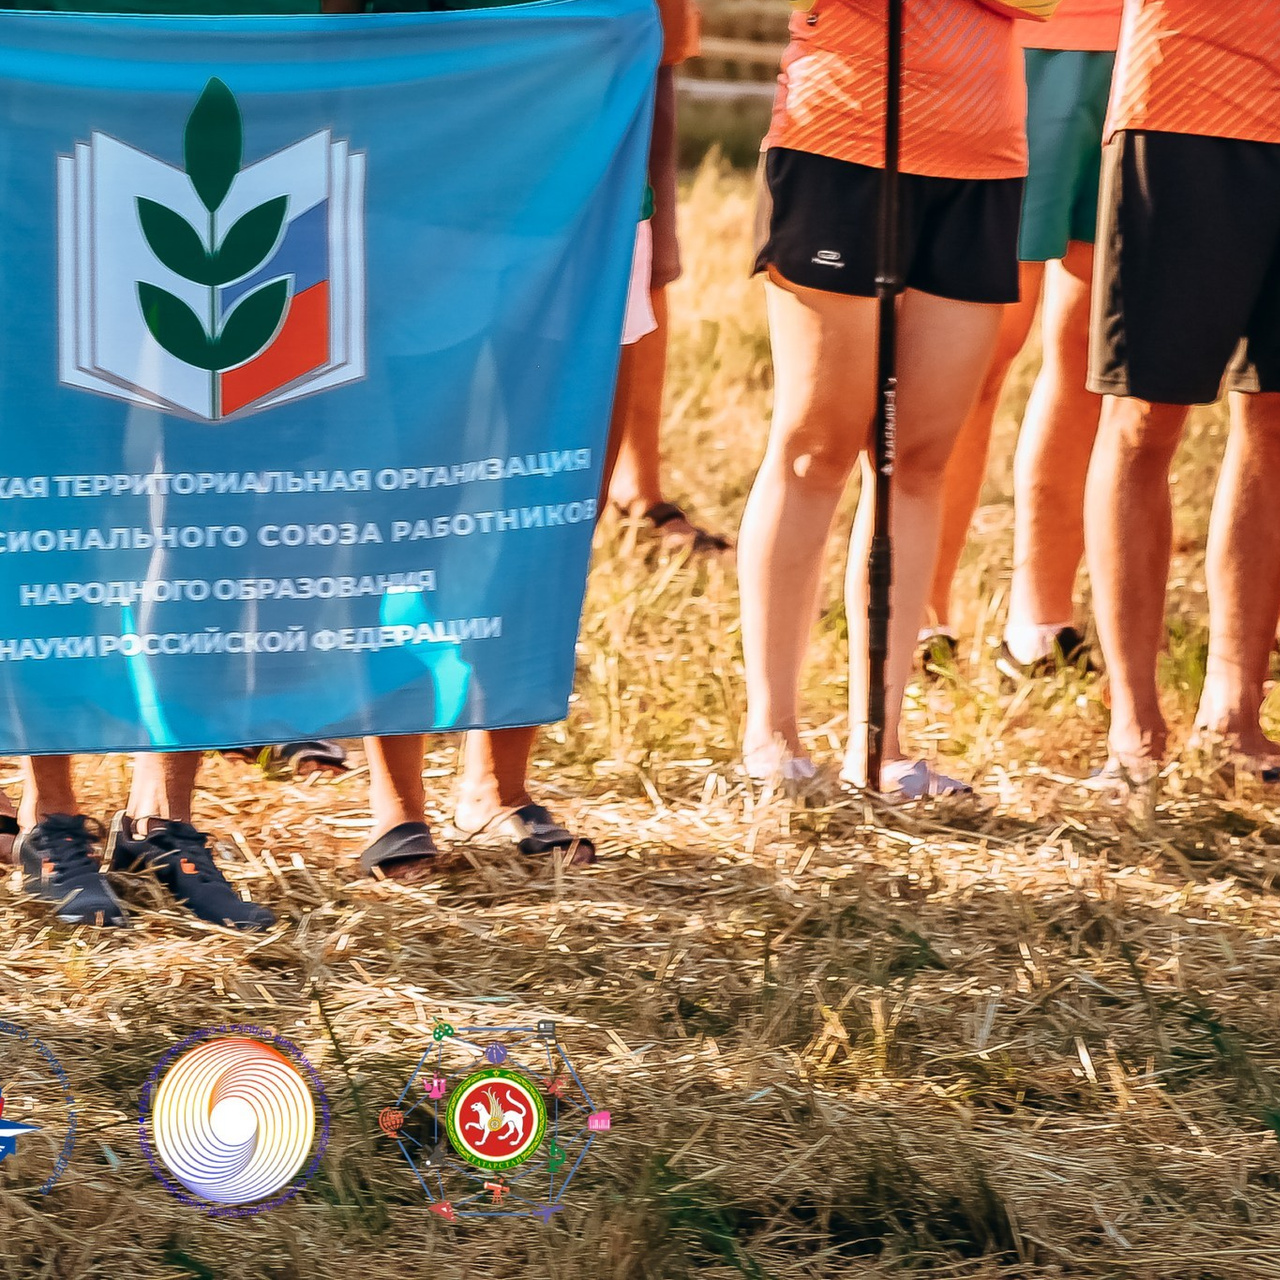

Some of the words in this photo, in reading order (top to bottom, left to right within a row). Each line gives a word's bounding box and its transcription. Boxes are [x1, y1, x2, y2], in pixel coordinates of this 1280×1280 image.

[53, 469, 370, 502] ТЕРРИТОРИАЛЬНАЯ
[375, 447, 592, 493] ОРГАНИЗАЦИЯ
[257, 519, 383, 549] СОЮЗА
[391, 497, 599, 543] РАБОТНИКОВ
[19, 578, 210, 608] НАРОДНОГО
[212, 568, 437, 603] ОБРАЗОВАНИЯ
[98, 625, 309, 659] РОССИЙСКОЙ
[311, 616, 504, 655] ФЕДЕРАЦИИ
